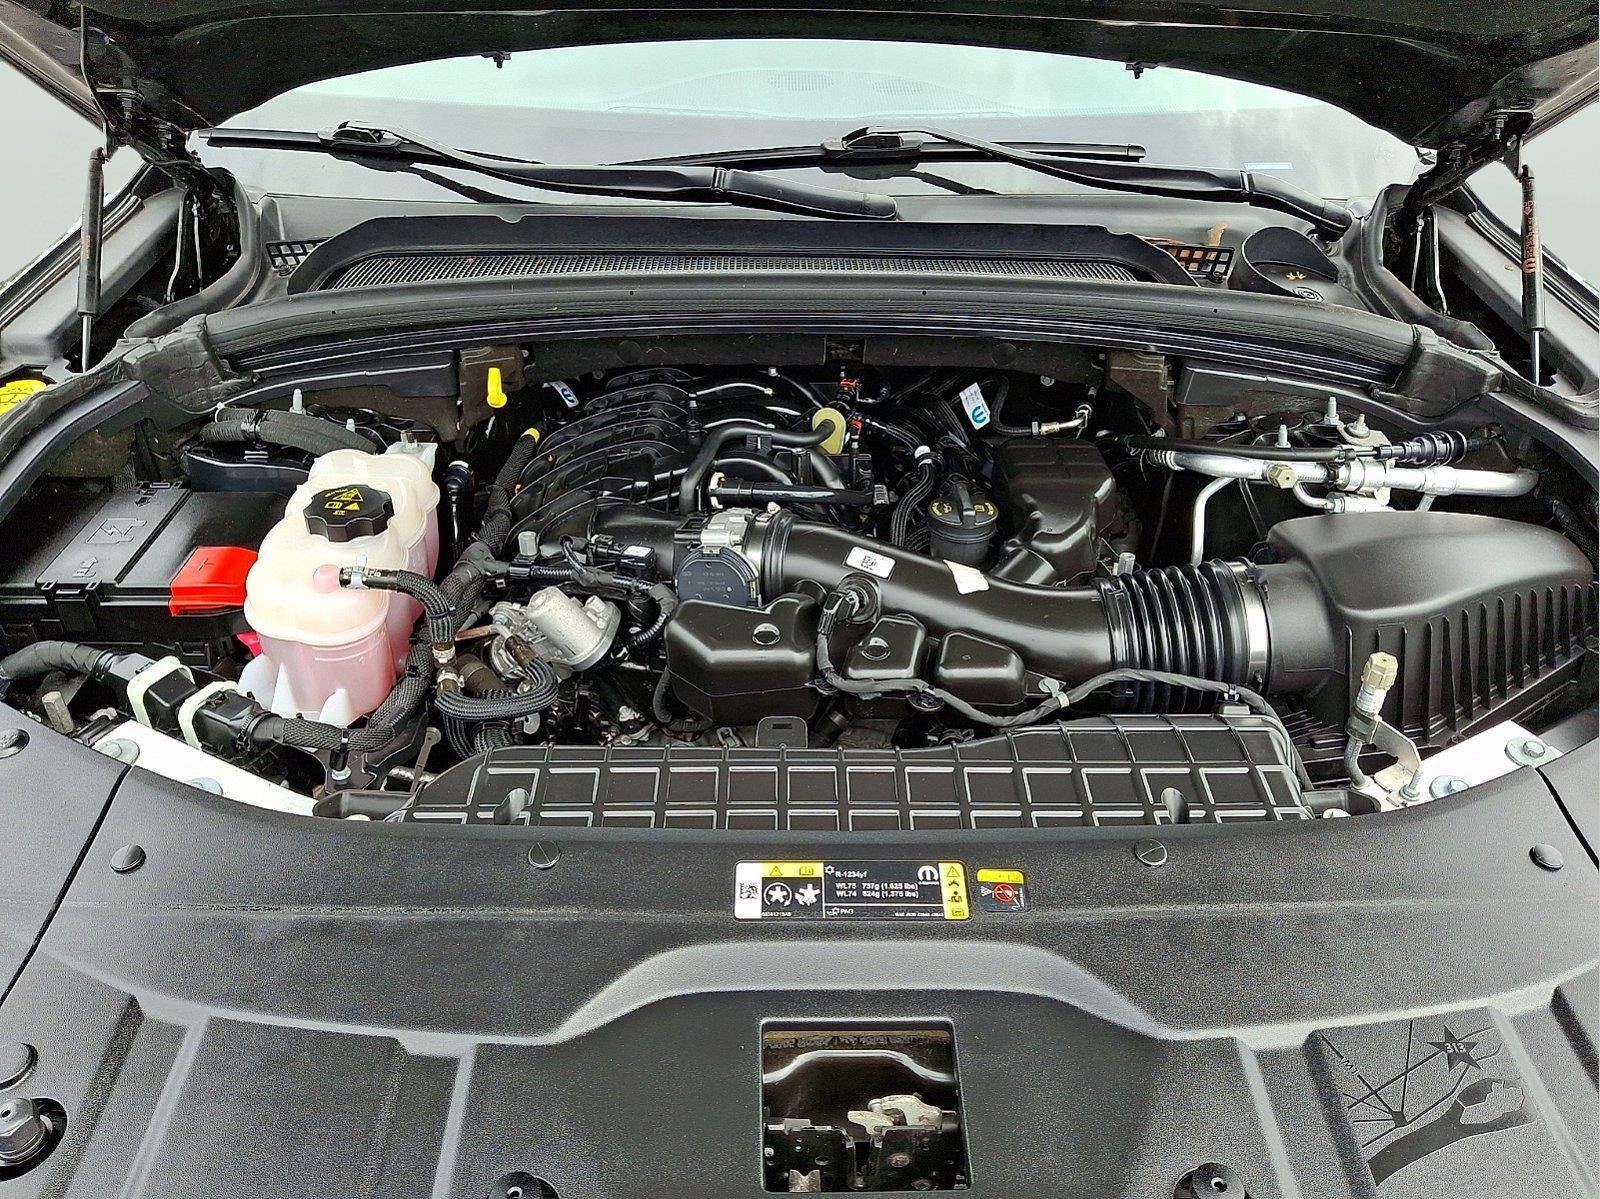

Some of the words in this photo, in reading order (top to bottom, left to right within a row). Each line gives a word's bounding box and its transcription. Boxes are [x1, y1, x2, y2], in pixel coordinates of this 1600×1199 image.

[835, 870, 868, 879] R-1234yf
[835, 882, 857, 890] WL75
[861, 882, 880, 891] 737g
[1444, 1042, 1466, 1054] 313
